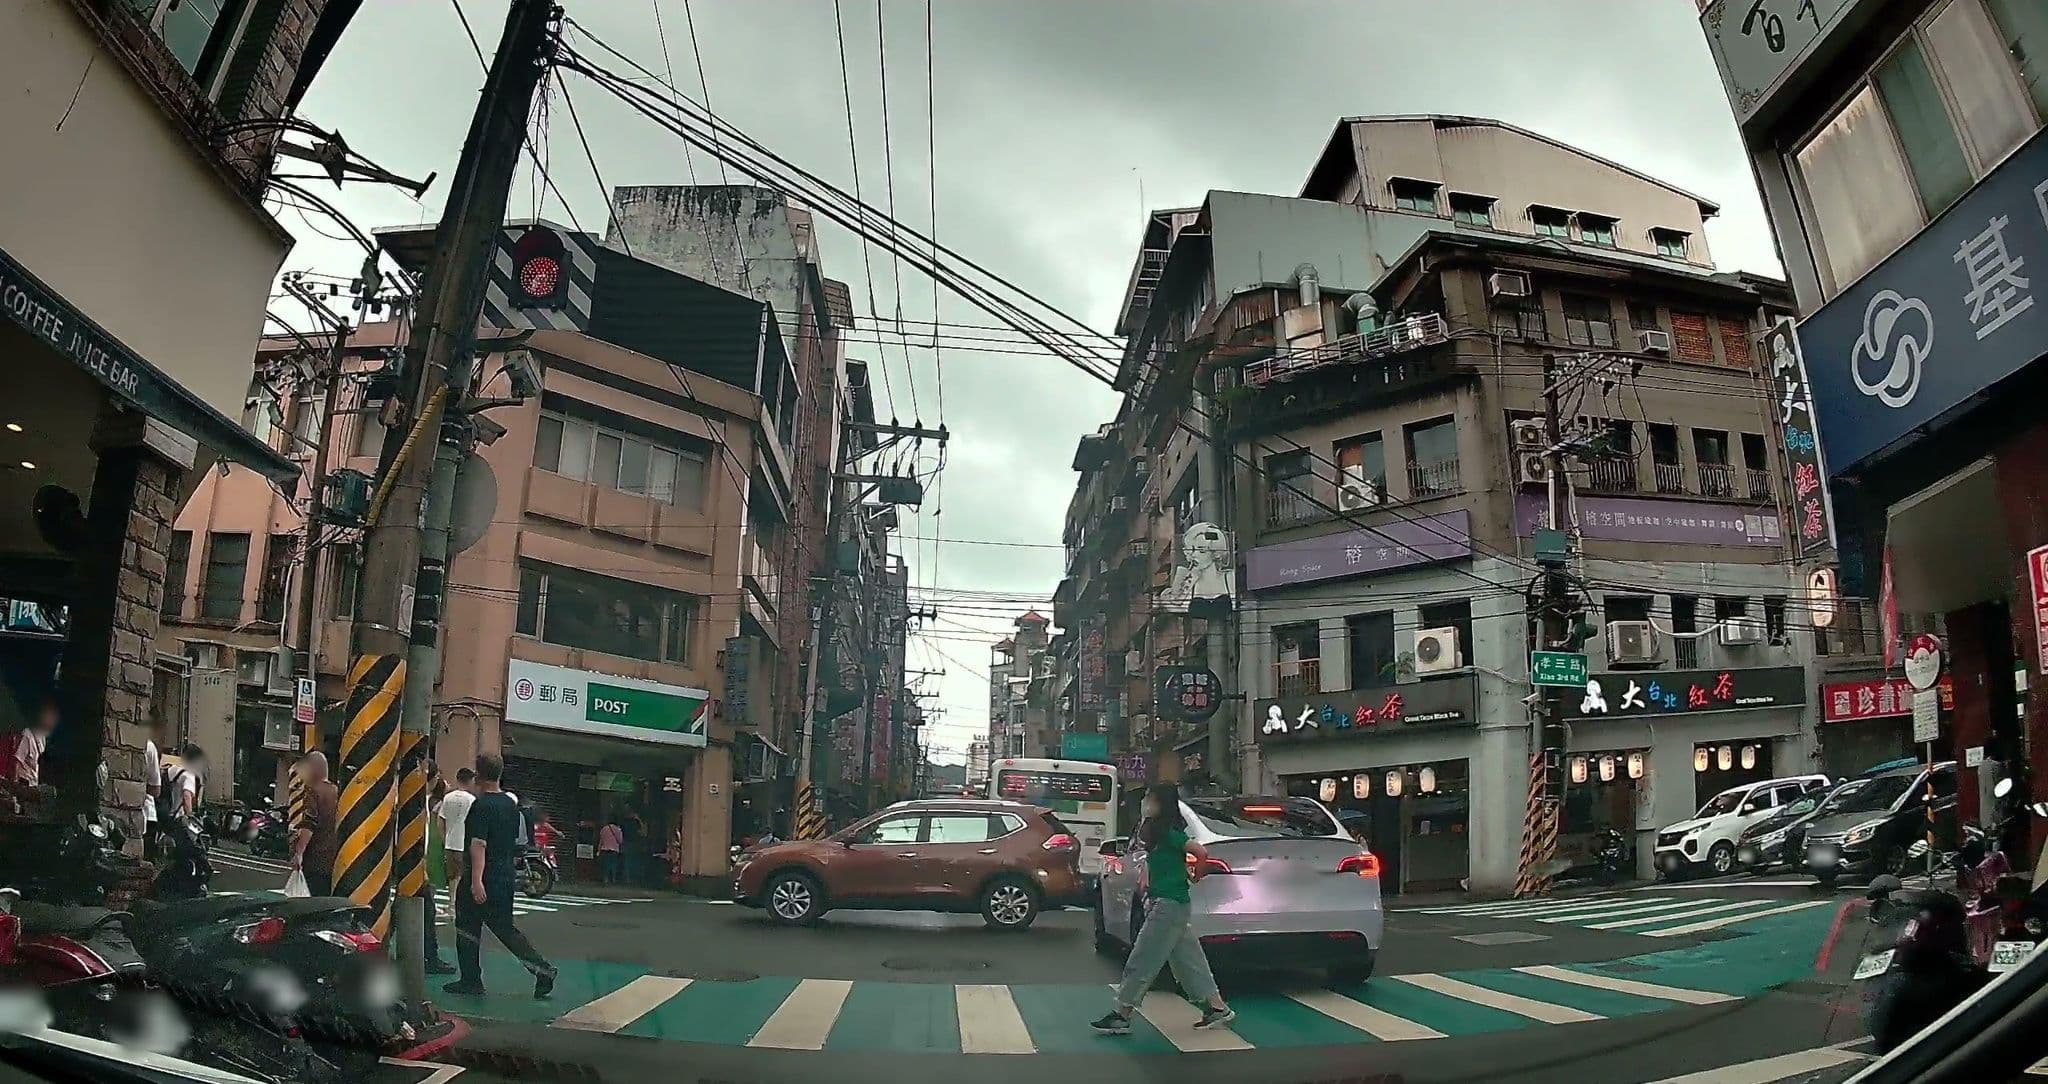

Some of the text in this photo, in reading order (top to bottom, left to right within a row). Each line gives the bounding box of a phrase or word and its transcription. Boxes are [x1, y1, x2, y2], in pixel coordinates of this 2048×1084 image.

[4, 285, 139, 395] COFFEE JUICE BAR
[539, 685, 578, 706] 郵局
[594, 698, 630, 715] POST
[1620, 673, 1734, 709] 大台北紅茶
[1295, 693, 1403, 730] 大台北紅茶
